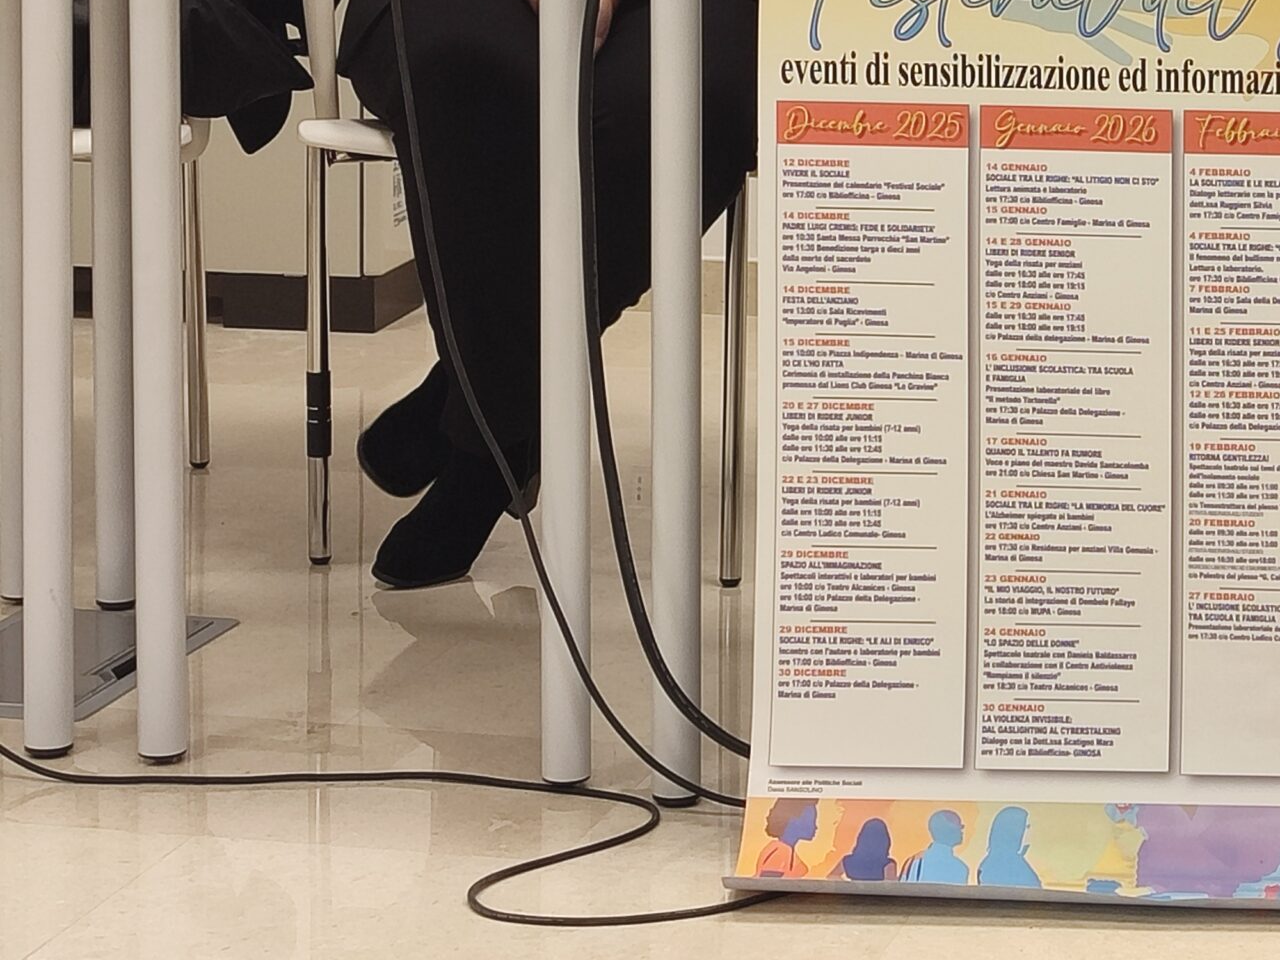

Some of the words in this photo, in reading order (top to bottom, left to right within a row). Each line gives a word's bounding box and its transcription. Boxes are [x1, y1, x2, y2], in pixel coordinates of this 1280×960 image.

[781, 50, 857, 85] eventi
[866, 51, 889, 86] di
[898, 52, 1110, 92] sensibilizzazione
[1118, 58, 1146, 92] ed
[783, 106, 890, 141] Dicembre
[893, 110, 963, 141] 2025
[994, 109, 1087, 148] Gennaio
[1090, 113, 1157, 143] 2026
[797, 159, 850, 167] DICEMBRE
[986, 163, 998, 171] 14
[820, 170, 850, 178] SOCIALE
[1190, 168, 1195, 176] 4
[986, 206, 998, 214] 15
[797, 212, 850, 220] DICEMBRE
[1190, 232, 1195, 240] 4
[1025, 239, 1071, 247] GENNAIO
[798, 286, 850, 294] DICEMBRE
[1010, 302, 1022, 310] 29
[1025, 302, 1071, 311] GENNAIO
[1214, 328, 1226, 336] 25
[1229, 328, 1280, 336] FEBBRAIO
[798, 339, 850, 347] DICEMBRE
[1001, 354, 1047, 362] GENNAIO
[1229, 391, 1280, 399] FEBBRAIO
[798, 402, 804, 410] E
[807, 402, 819, 410] 27
[822, 403, 874, 411] DICEMBRE
[817, 413, 843, 421] RIDERE
[1001, 438, 1047, 446] GENNAIO
[1204, 444, 1256, 452] FEBBRAIO
[986, 448, 1016, 456] QUANDO
[1027, 449, 1059, 457] TALENTO
[1072, 450, 1102, 458] RUMORE
[1189, 454, 1221, 462] RITORNA
[797, 476, 804, 484] E
[806, 476, 818, 484] 23
[985, 490, 997, 498] 21
[1001, 491, 1047, 499] GENNAIO
[1204, 519, 1255, 527] FEBBRAIO
[999, 533, 1040, 541] GENNAIO
[1000, 575, 1046, 583] GENNAIO
[1189, 592, 1200, 600] 27
[1204, 593, 1255, 601] FEBBRAIO
[795, 626, 847, 634] DICEMBRE
[984, 628, 996, 636] 24
[1000, 628, 1046, 636] GENNAIO
[794, 669, 847, 677] DICEMBRE
[998, 704, 1045, 712] GENNAIO
[982, 715, 991, 723] LA
